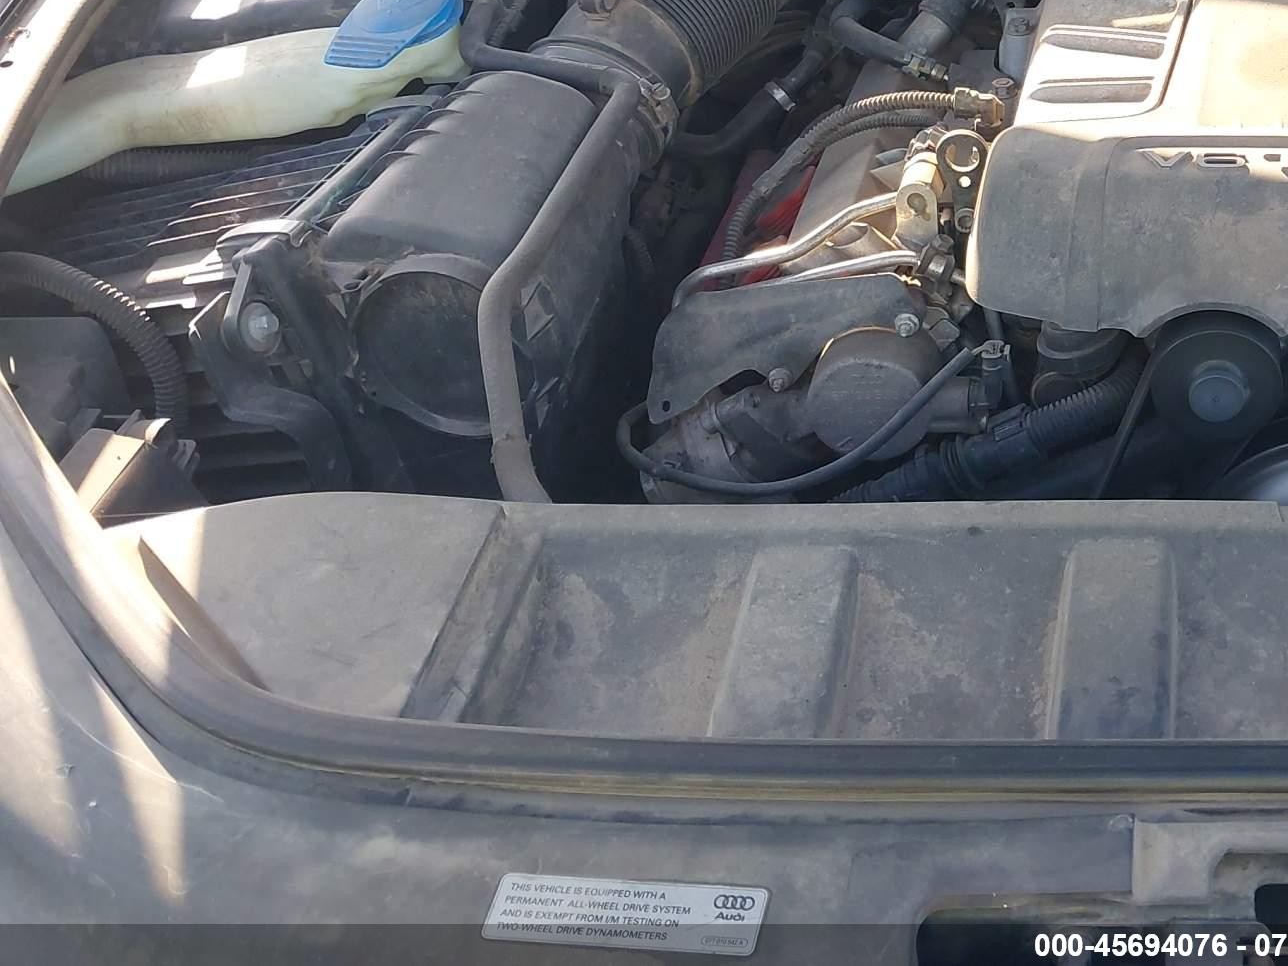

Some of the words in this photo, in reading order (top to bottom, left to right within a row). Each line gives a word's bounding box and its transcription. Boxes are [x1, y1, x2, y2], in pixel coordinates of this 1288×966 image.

[511, 882, 532, 892] THIS
[534, 884, 572, 895] VEHICLE
[574, 886, 583, 895] IS
[585, 887, 631, 899] EQUIPPED
[633, 890, 658, 900] WITH
[659, 892, 667, 901] A
[504, 895, 564, 907] PERMANENT
[567, 900, 619, 912] ALL-WHEEL
[623, 903, 650, 913] DRIVE
[652, 905, 692, 915] SYSTEM
[500, 908, 522, 918] AND
[523, 910, 532, 919] IS
[534, 911, 573, 921] EXEMPT
[575, 913, 604, 924] FROM
[605, 914, 620, 924] I/M
[623, 916, 663, 927] TESTING
[664, 919, 680, 928] ON
[714, 911, 745, 923] Audi
[496, 922, 553, 934] TWO-WHEEL
[556, 925, 584, 936] DRIVE
[585, 927, 668, 941] DYNAMOMETERS
